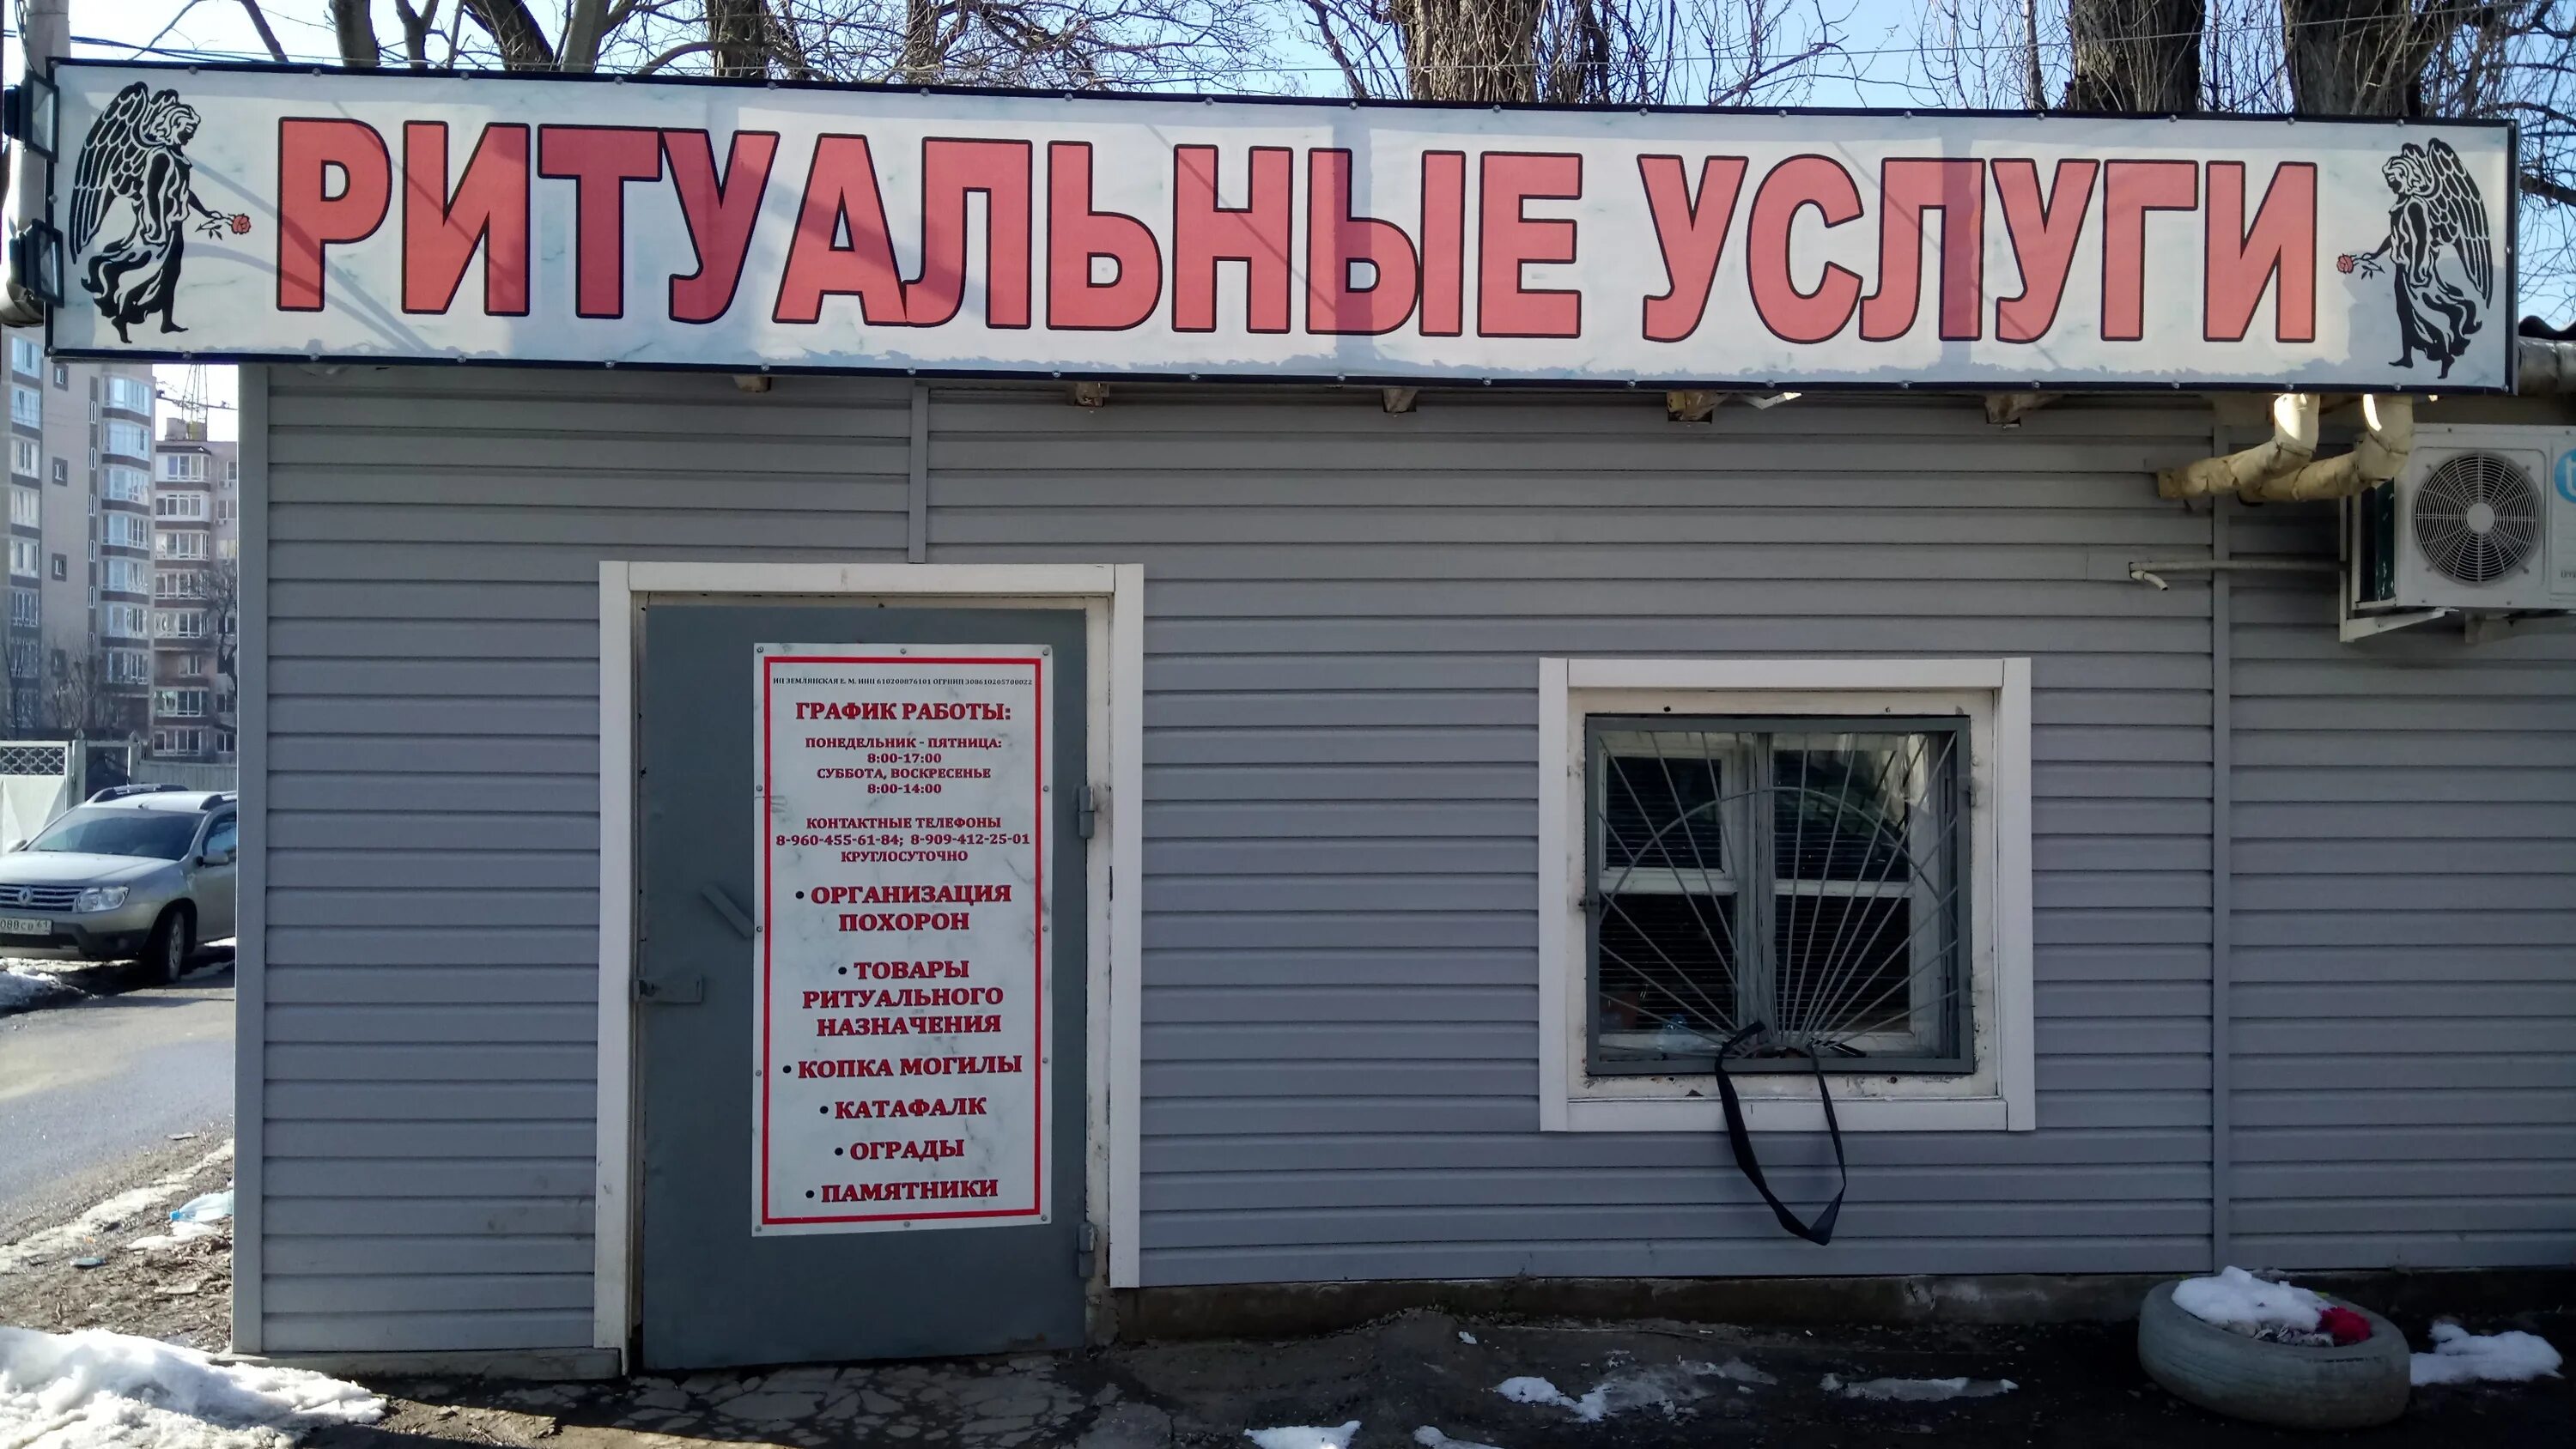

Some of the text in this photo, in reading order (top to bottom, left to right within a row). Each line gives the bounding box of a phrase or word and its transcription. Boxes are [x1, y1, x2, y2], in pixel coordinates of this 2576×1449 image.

[276, 117, 2318, 343] РИТУАЛЬНЫЕ УСЛУГИ
[795, 701, 1011, 720] ГРАФИК РАБОТЫ:
[805, 737, 916, 750] ПОНЕДЕЛЬНИК
[928, 738, 1001, 749] ПЯТНИЦА:
[867, 753, 941, 764] 8:00-17:00
[817, 768, 990, 780] СУББОТА, ВОСКРЕСЕНЬЕ
[867, 784, 941, 794] 8:00-14:00
[806, 816, 1001, 828] КОНТАКТНЫЕ ТЕЛЕФОНЫ
[775, 834, 1030, 846] 8-960-455-61-84; 8-909-412-25-01
[841, 851, 968, 862] КРУГЛОСУТОЧНО
[811, 884, 1012, 906] ОРГАНИЗАЦИЯ
[838, 912, 969, 931] ПОХОРОН
[854, 961, 969, 979] ТОВАРЫ
[802, 987, 1003, 1009] РИТУАЛЬНОГО
[817, 1016, 1001, 1037] НАЗНАЧЕНИЯ
[798, 1056, 1022, 1078] КОПКА МОГИЛЫ
[835, 1097, 987, 1119] КАТАФАЛК
[850, 1139, 964, 1161] ОГРАДЫ
[822, 1179, 998, 1202] ПАМЯТНИКИ
